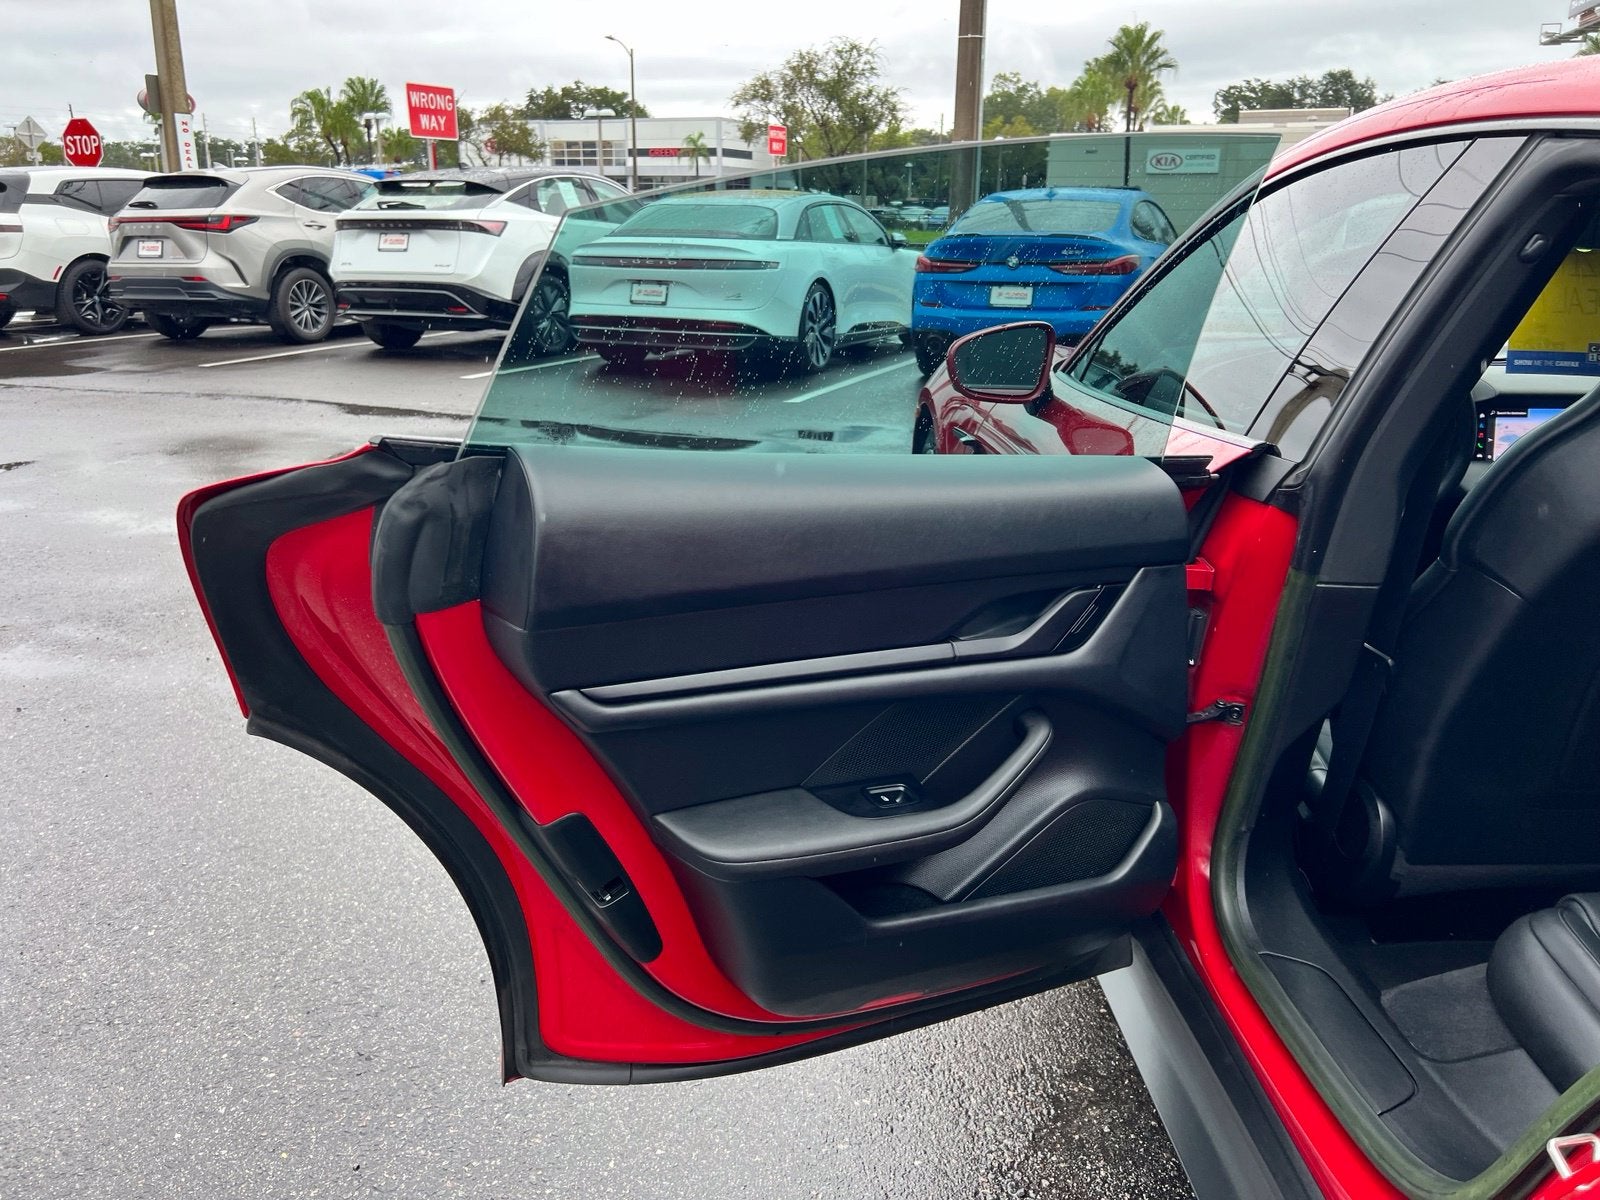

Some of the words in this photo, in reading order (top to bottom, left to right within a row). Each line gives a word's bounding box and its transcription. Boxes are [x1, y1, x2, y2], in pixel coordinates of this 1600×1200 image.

[409, 91, 453, 111] WRONG
[419, 113, 446, 131] WAY
[66, 135, 99, 155] STOP
[181, 121, 189, 133] NO
[185, 142, 193, 168] DEAL
[1155, 156, 1177, 167] KIA
